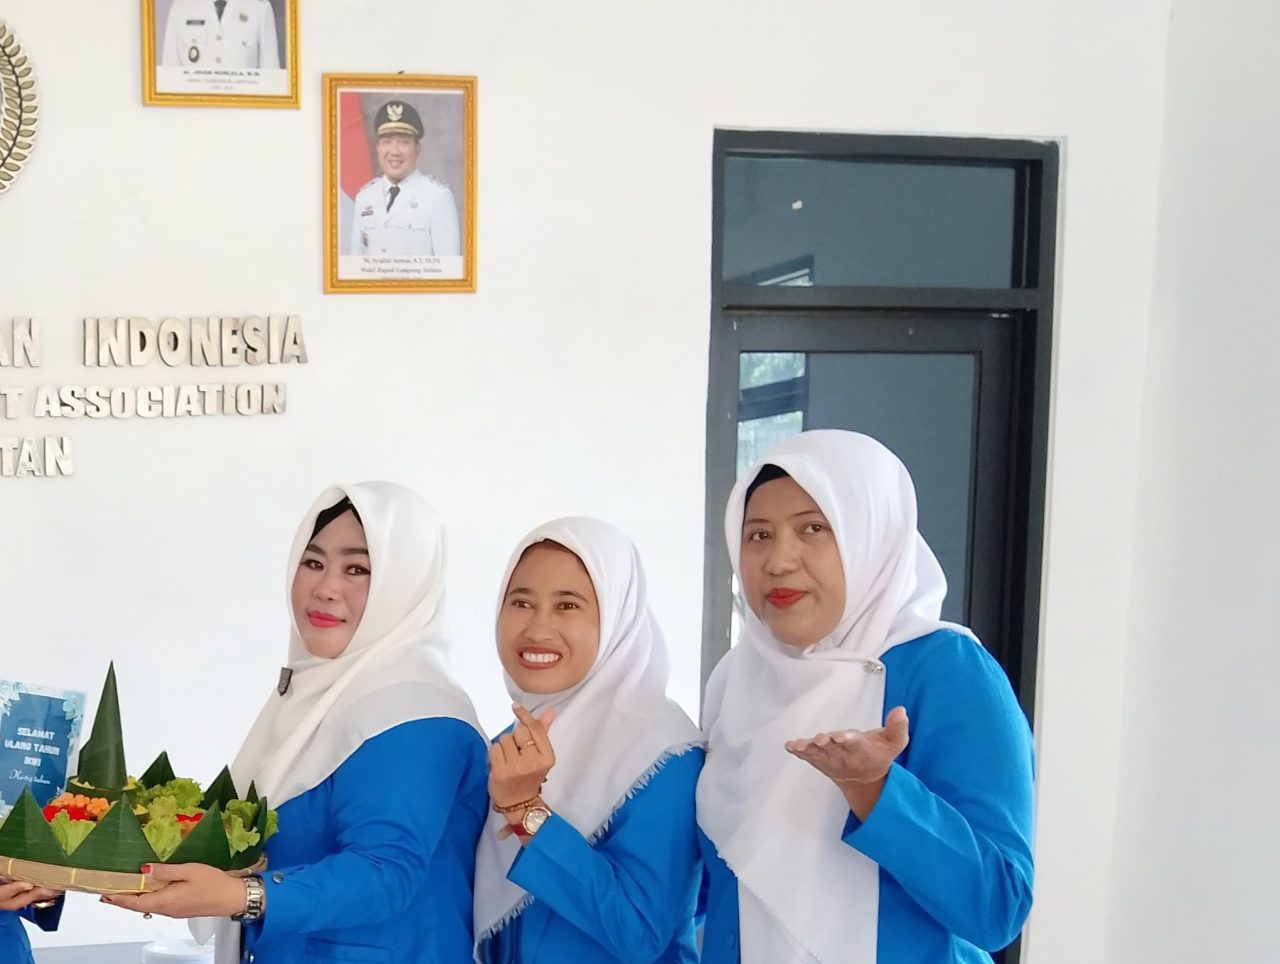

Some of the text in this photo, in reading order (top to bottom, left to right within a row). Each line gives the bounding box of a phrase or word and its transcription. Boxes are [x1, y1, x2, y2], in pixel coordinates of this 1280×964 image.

[82, 314, 309, 368] INDONESIA
[34, 382, 287, 419] ASSOCIATION
[17, 727, 55, 740] SELAMAT
[4, 739, 60, 755] ULANG TAHUN
